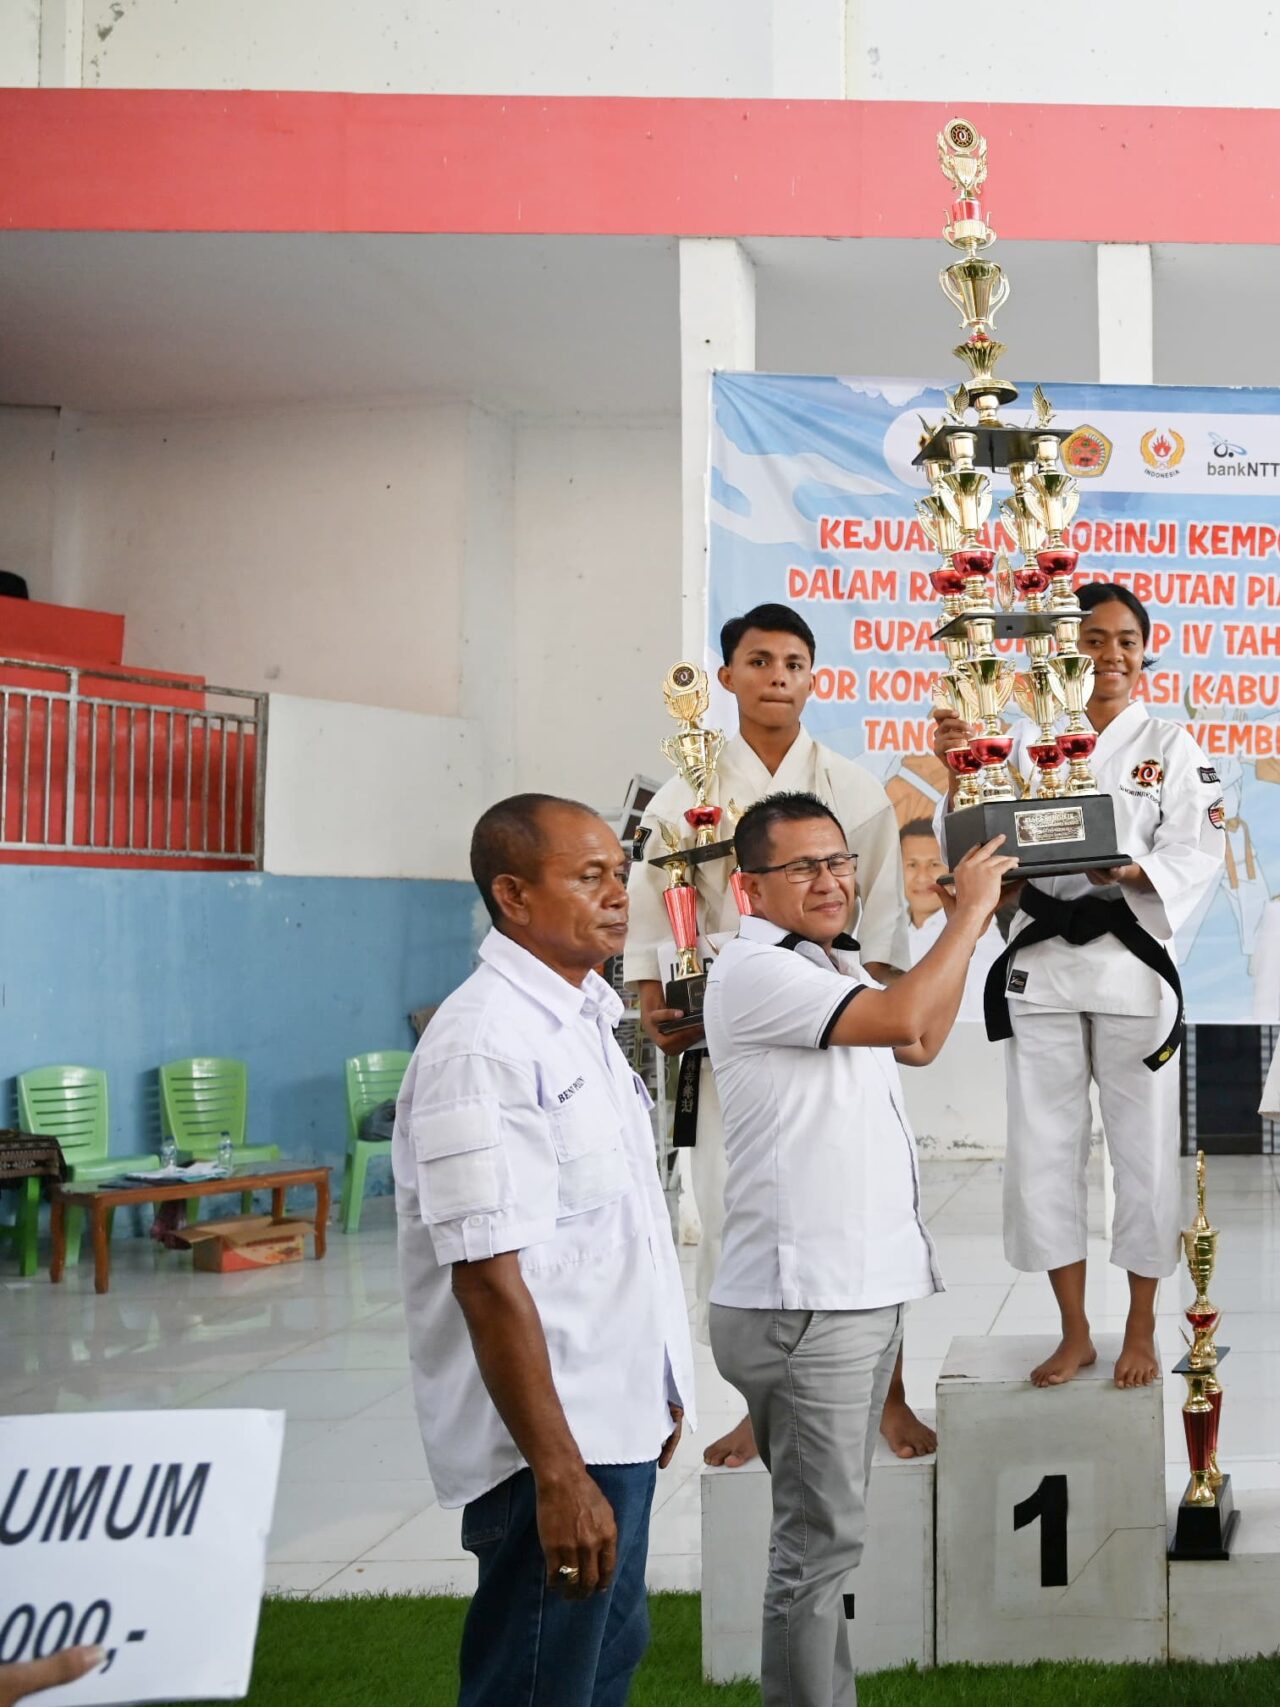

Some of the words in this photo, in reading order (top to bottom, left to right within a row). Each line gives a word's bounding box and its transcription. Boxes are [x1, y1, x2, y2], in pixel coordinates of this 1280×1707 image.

[1144, 468, 1180, 479] INDONESIA
[1207, 462, 1280, 478] bankNTT
[820, 518, 1016, 552] KEJUAAN
[788, 568, 897, 601] DALAM
[1183, 624, 1213, 655] IV
[0, 1462, 212, 1546] UMUM
[1013, 1474, 1069, 1587] 1
